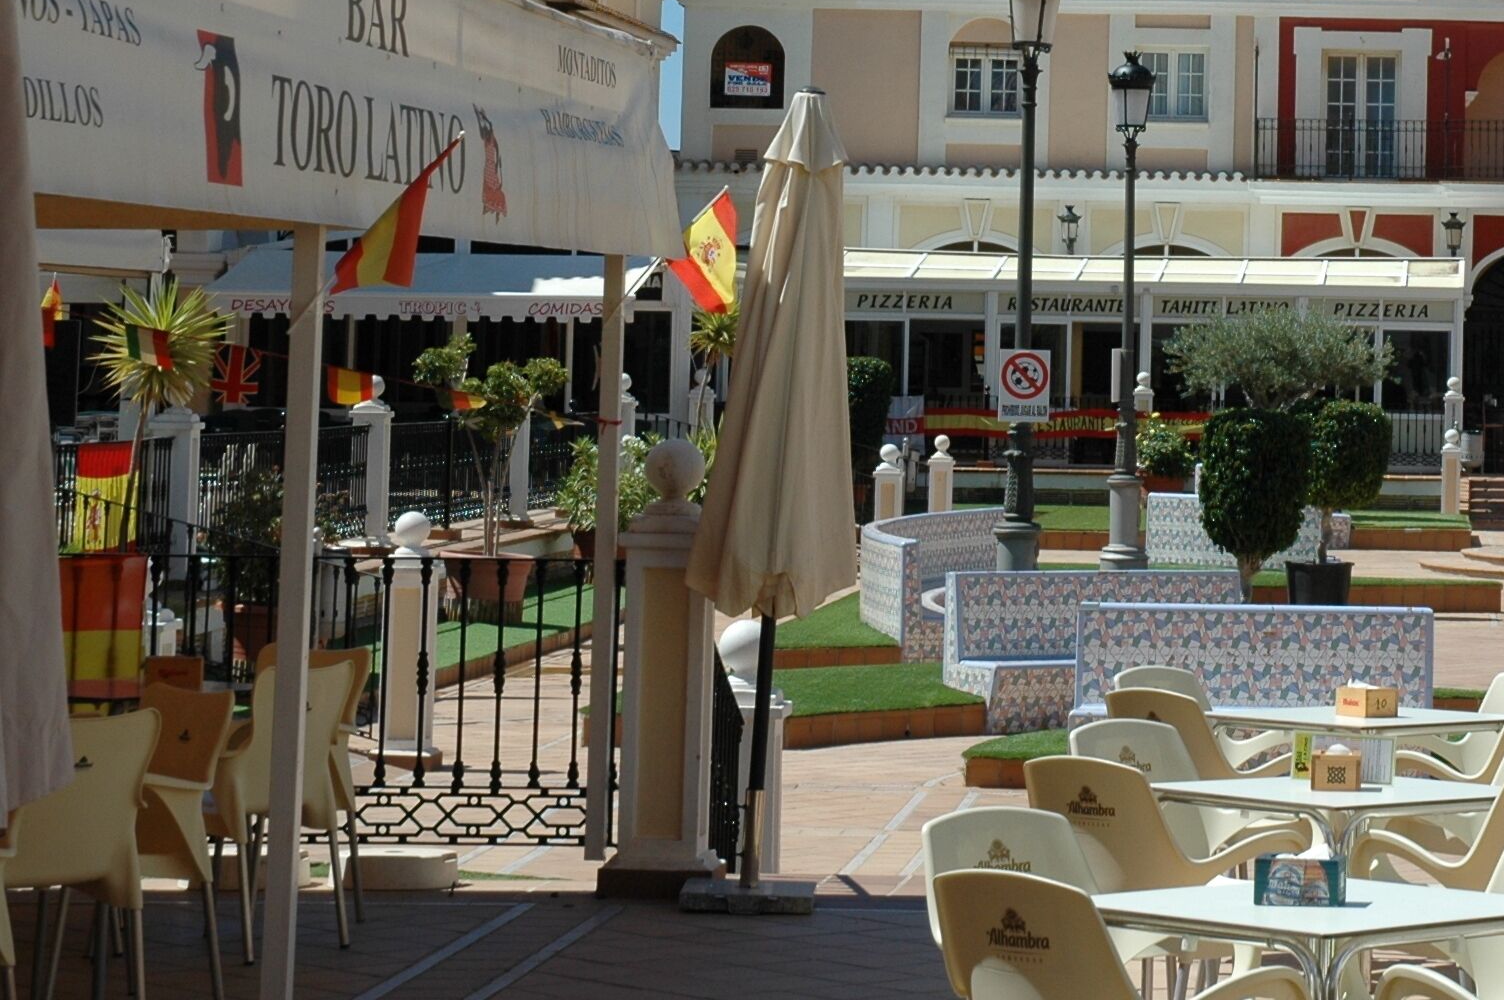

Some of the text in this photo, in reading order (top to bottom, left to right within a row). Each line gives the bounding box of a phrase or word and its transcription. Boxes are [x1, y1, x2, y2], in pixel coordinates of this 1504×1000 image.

[557, 44, 617, 89] MONTADITOS
[23, 76, 104, 129] DILLOS
[271, 73, 467, 195] TORO LATINO
[231, 299, 335, 313] DESAYS
[400, 301, 467, 315] TROPIC
[528, 302, 604, 316] COMIDAS
[856, 294, 953, 310] PIZZERIA
[1007, 296, 1124, 313] RSTAURANTE
[1333, 302, 1430, 319] PIZZERIA
[1038, 415, 1107, 432] ESTAURANTE
[1375, 698, 1387, 710] 10
[1066, 801, 1116, 817] Alhambra
[986, 927, 1050, 950] Alhambra
